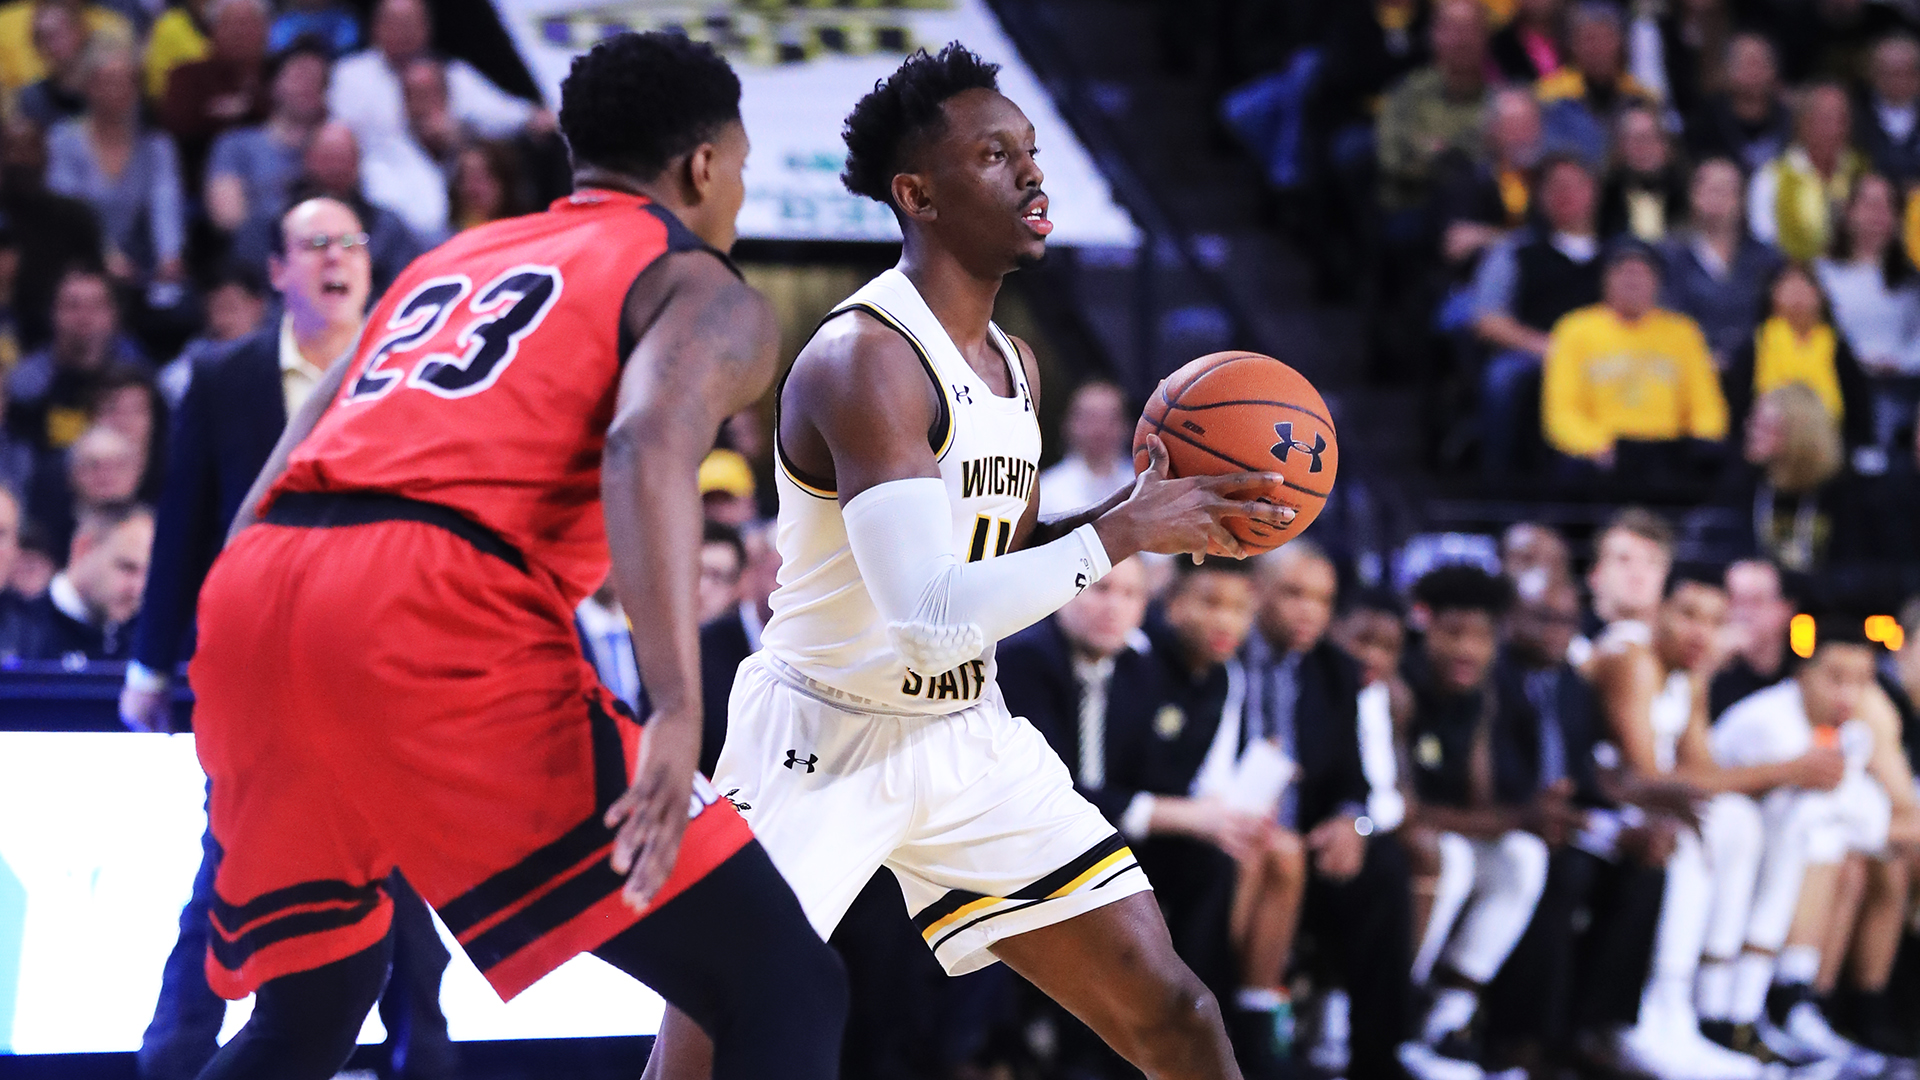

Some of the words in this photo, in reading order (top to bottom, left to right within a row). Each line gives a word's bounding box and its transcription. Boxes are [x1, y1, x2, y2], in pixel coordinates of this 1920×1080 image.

[343, 264, 564, 407] 23
[961, 455, 1036, 503] WICHIT
[965, 513, 1011, 563] 11
